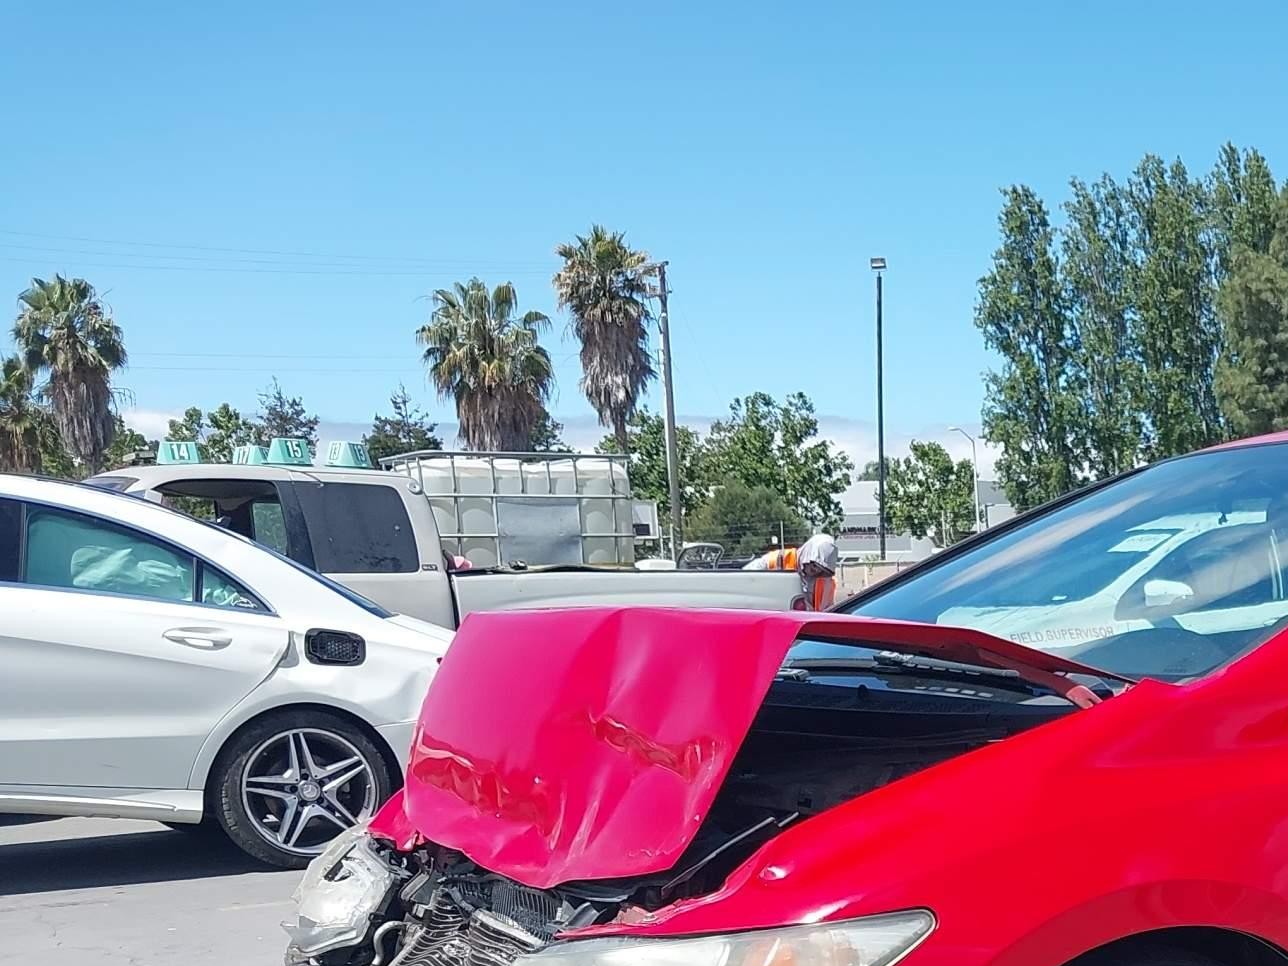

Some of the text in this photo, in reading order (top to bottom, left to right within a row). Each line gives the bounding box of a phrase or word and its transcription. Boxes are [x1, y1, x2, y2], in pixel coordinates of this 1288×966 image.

[171, 443, 189, 461] 14
[286, 440, 302, 458] 15
[1009, 625, 1115, 644] FIELD SUPERVISOR
